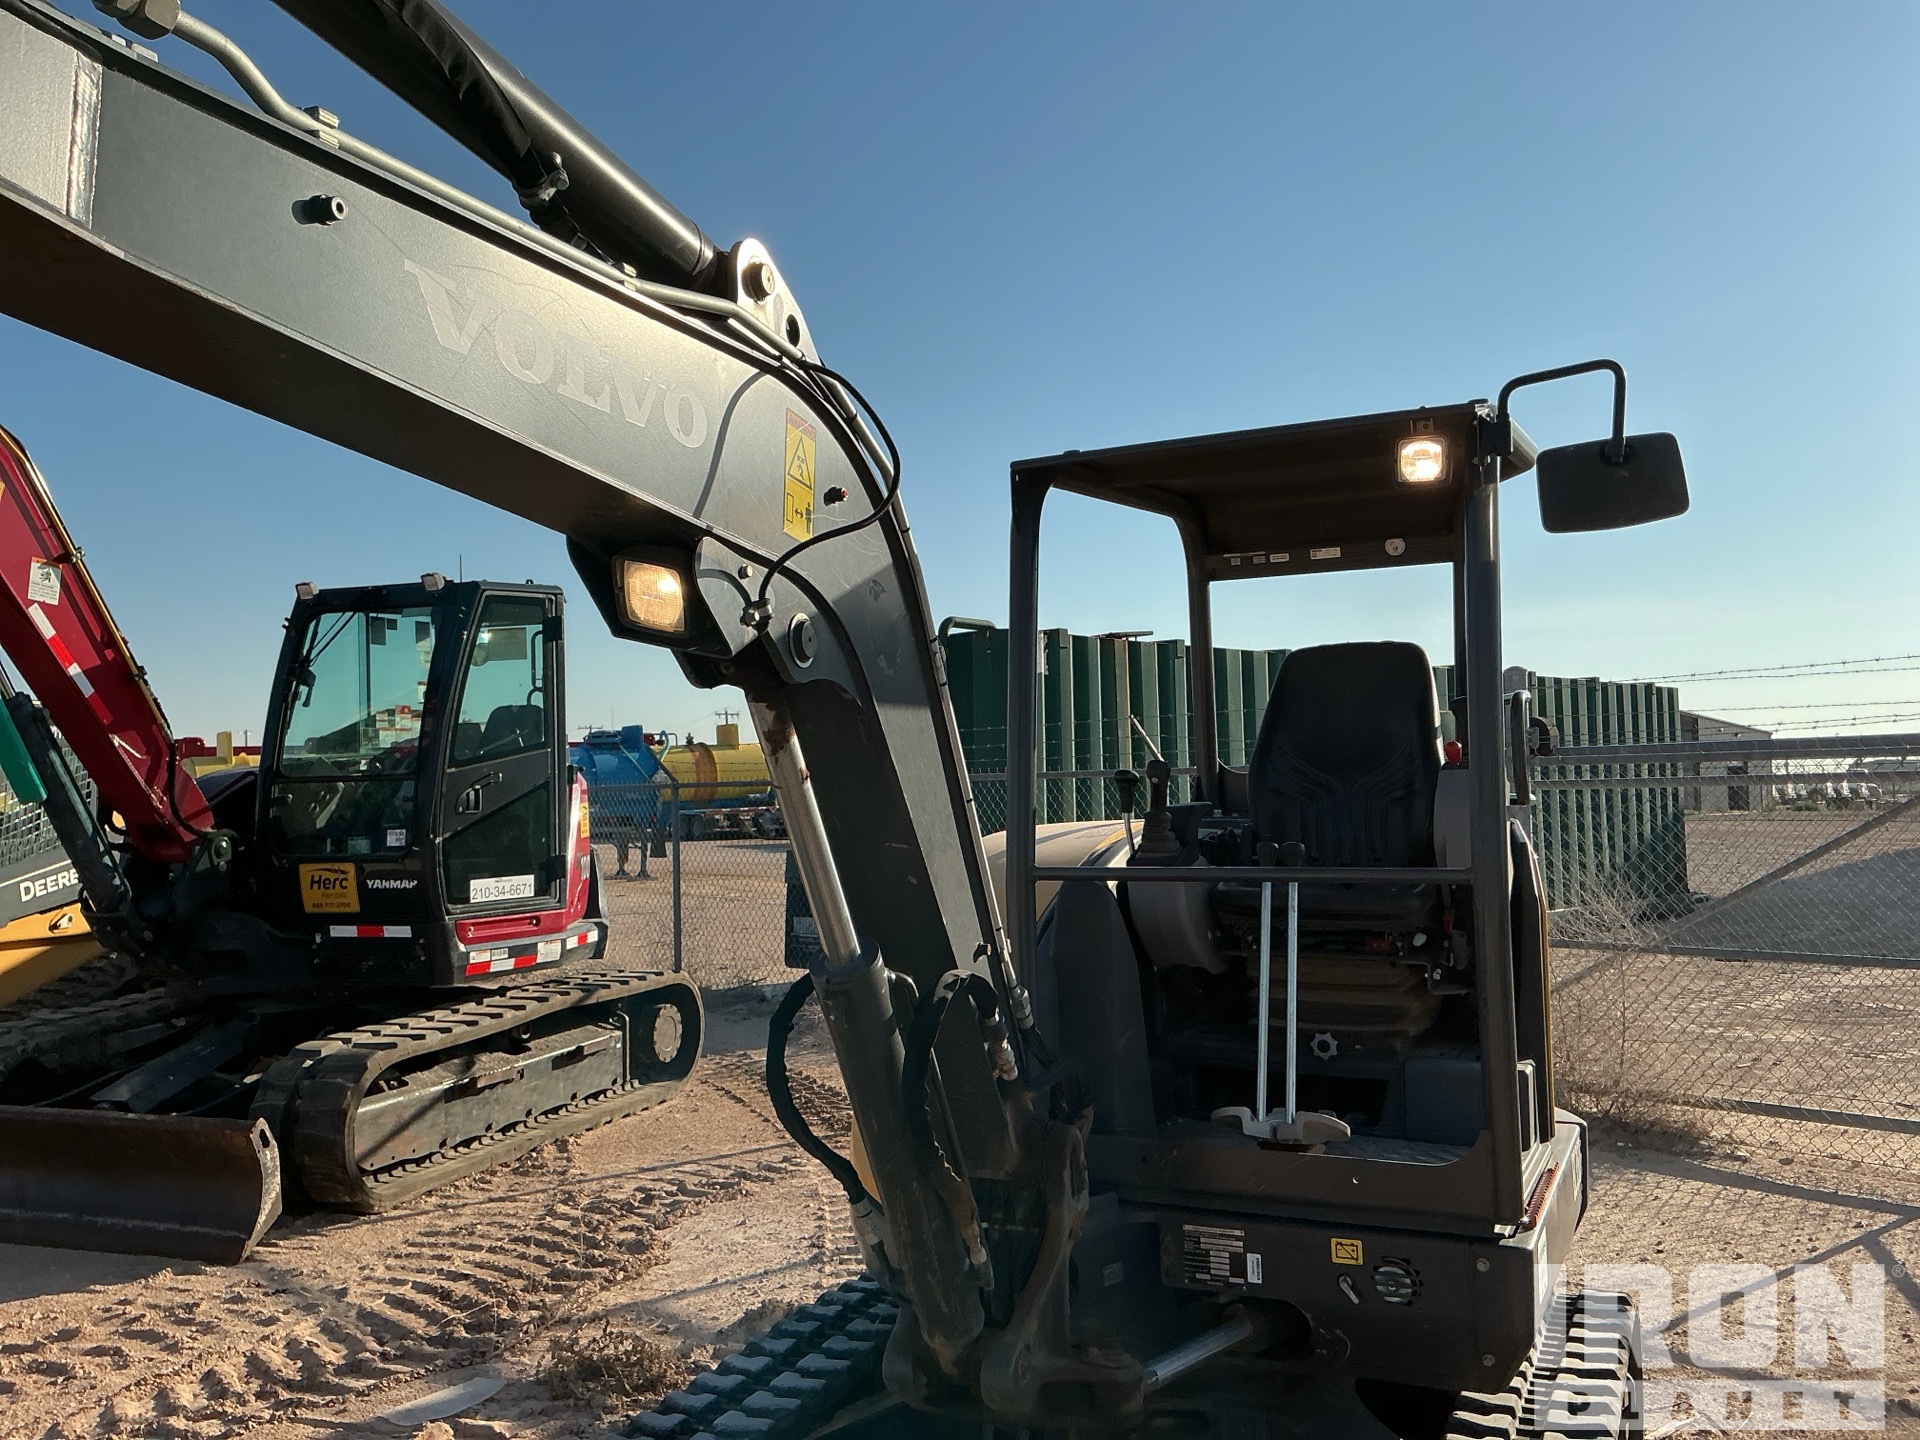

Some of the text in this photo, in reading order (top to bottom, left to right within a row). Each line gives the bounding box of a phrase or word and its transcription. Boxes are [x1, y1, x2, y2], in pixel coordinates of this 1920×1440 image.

[403, 257, 708, 449] VOLVO
[19, 867, 79, 903] DEERE
[309, 873, 349, 890] Herc
[366, 879, 418, 889] YANMAR
[471, 883, 532, 900] 210-34-6671
